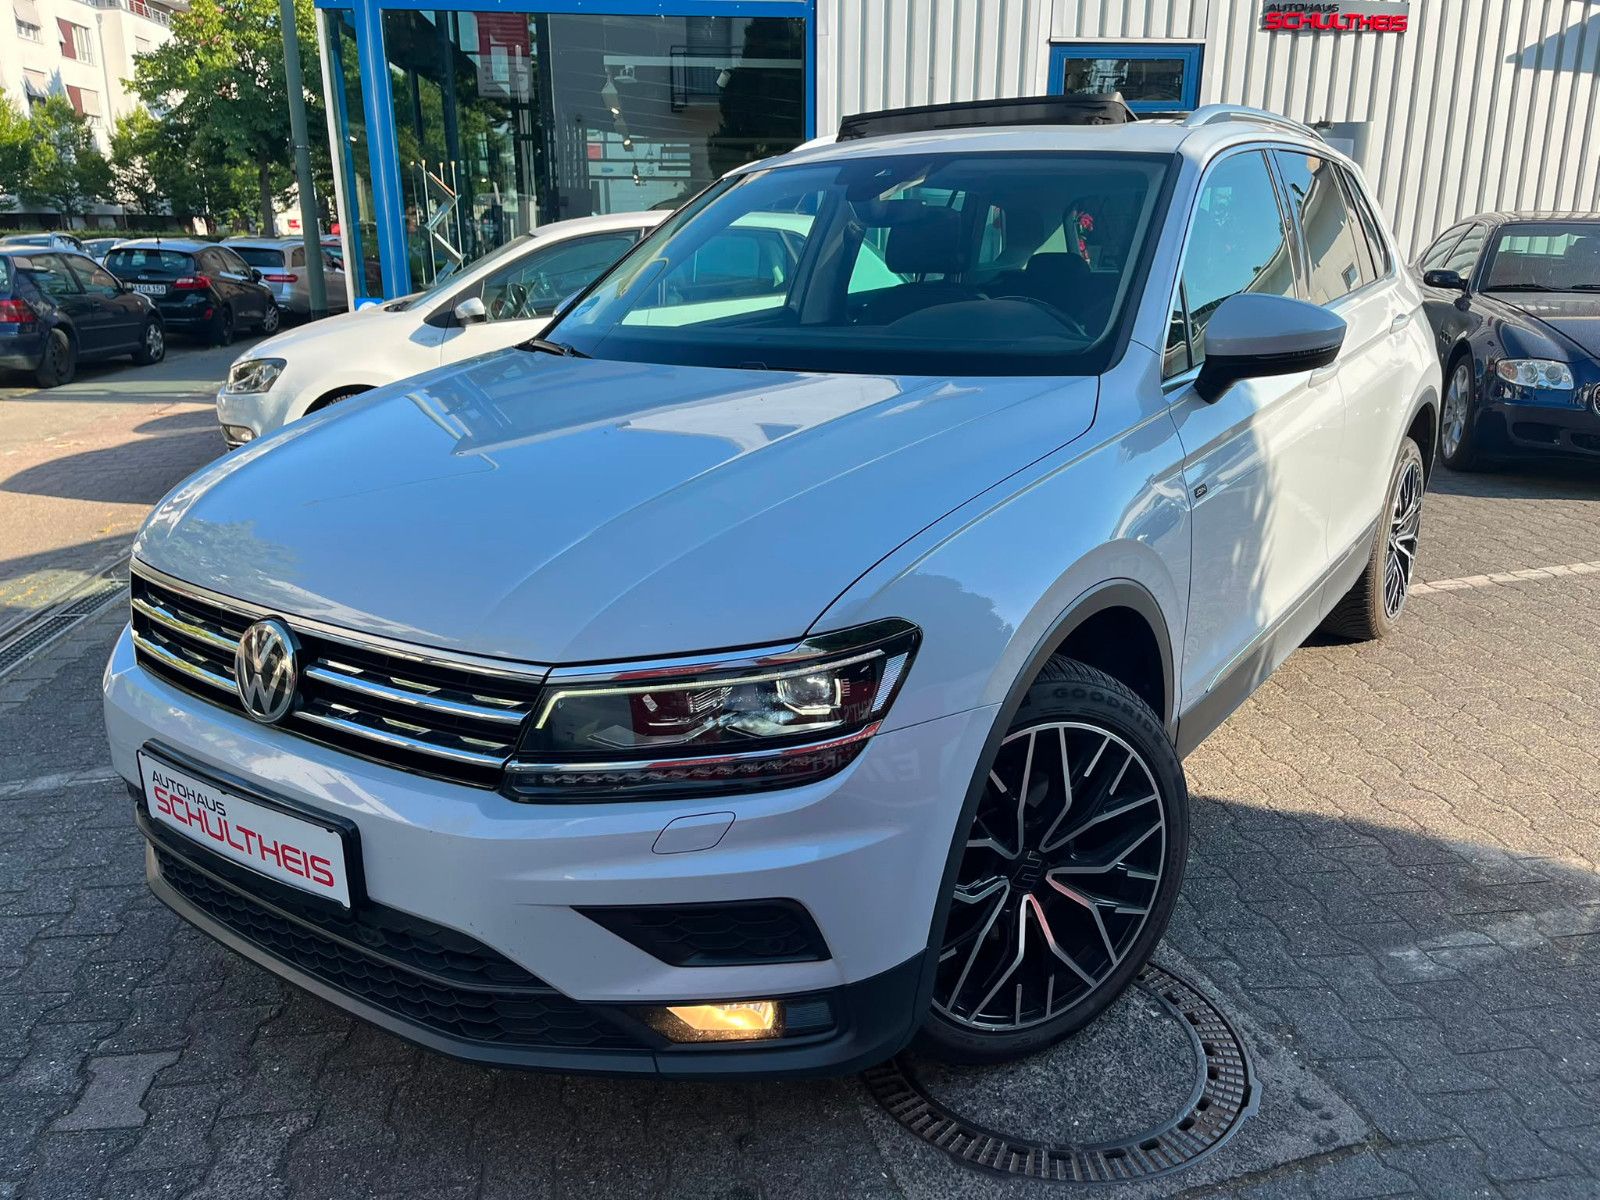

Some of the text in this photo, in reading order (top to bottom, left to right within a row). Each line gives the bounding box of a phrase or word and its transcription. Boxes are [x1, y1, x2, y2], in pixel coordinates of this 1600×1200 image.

[1264, 12, 1408, 32] SCHULTHEIS
[1265, 2, 1340, 13] AUTOHAUS
[152, 770, 227, 817] AUTOHAUS
[153, 786, 335, 888] SCHULTHEIS
